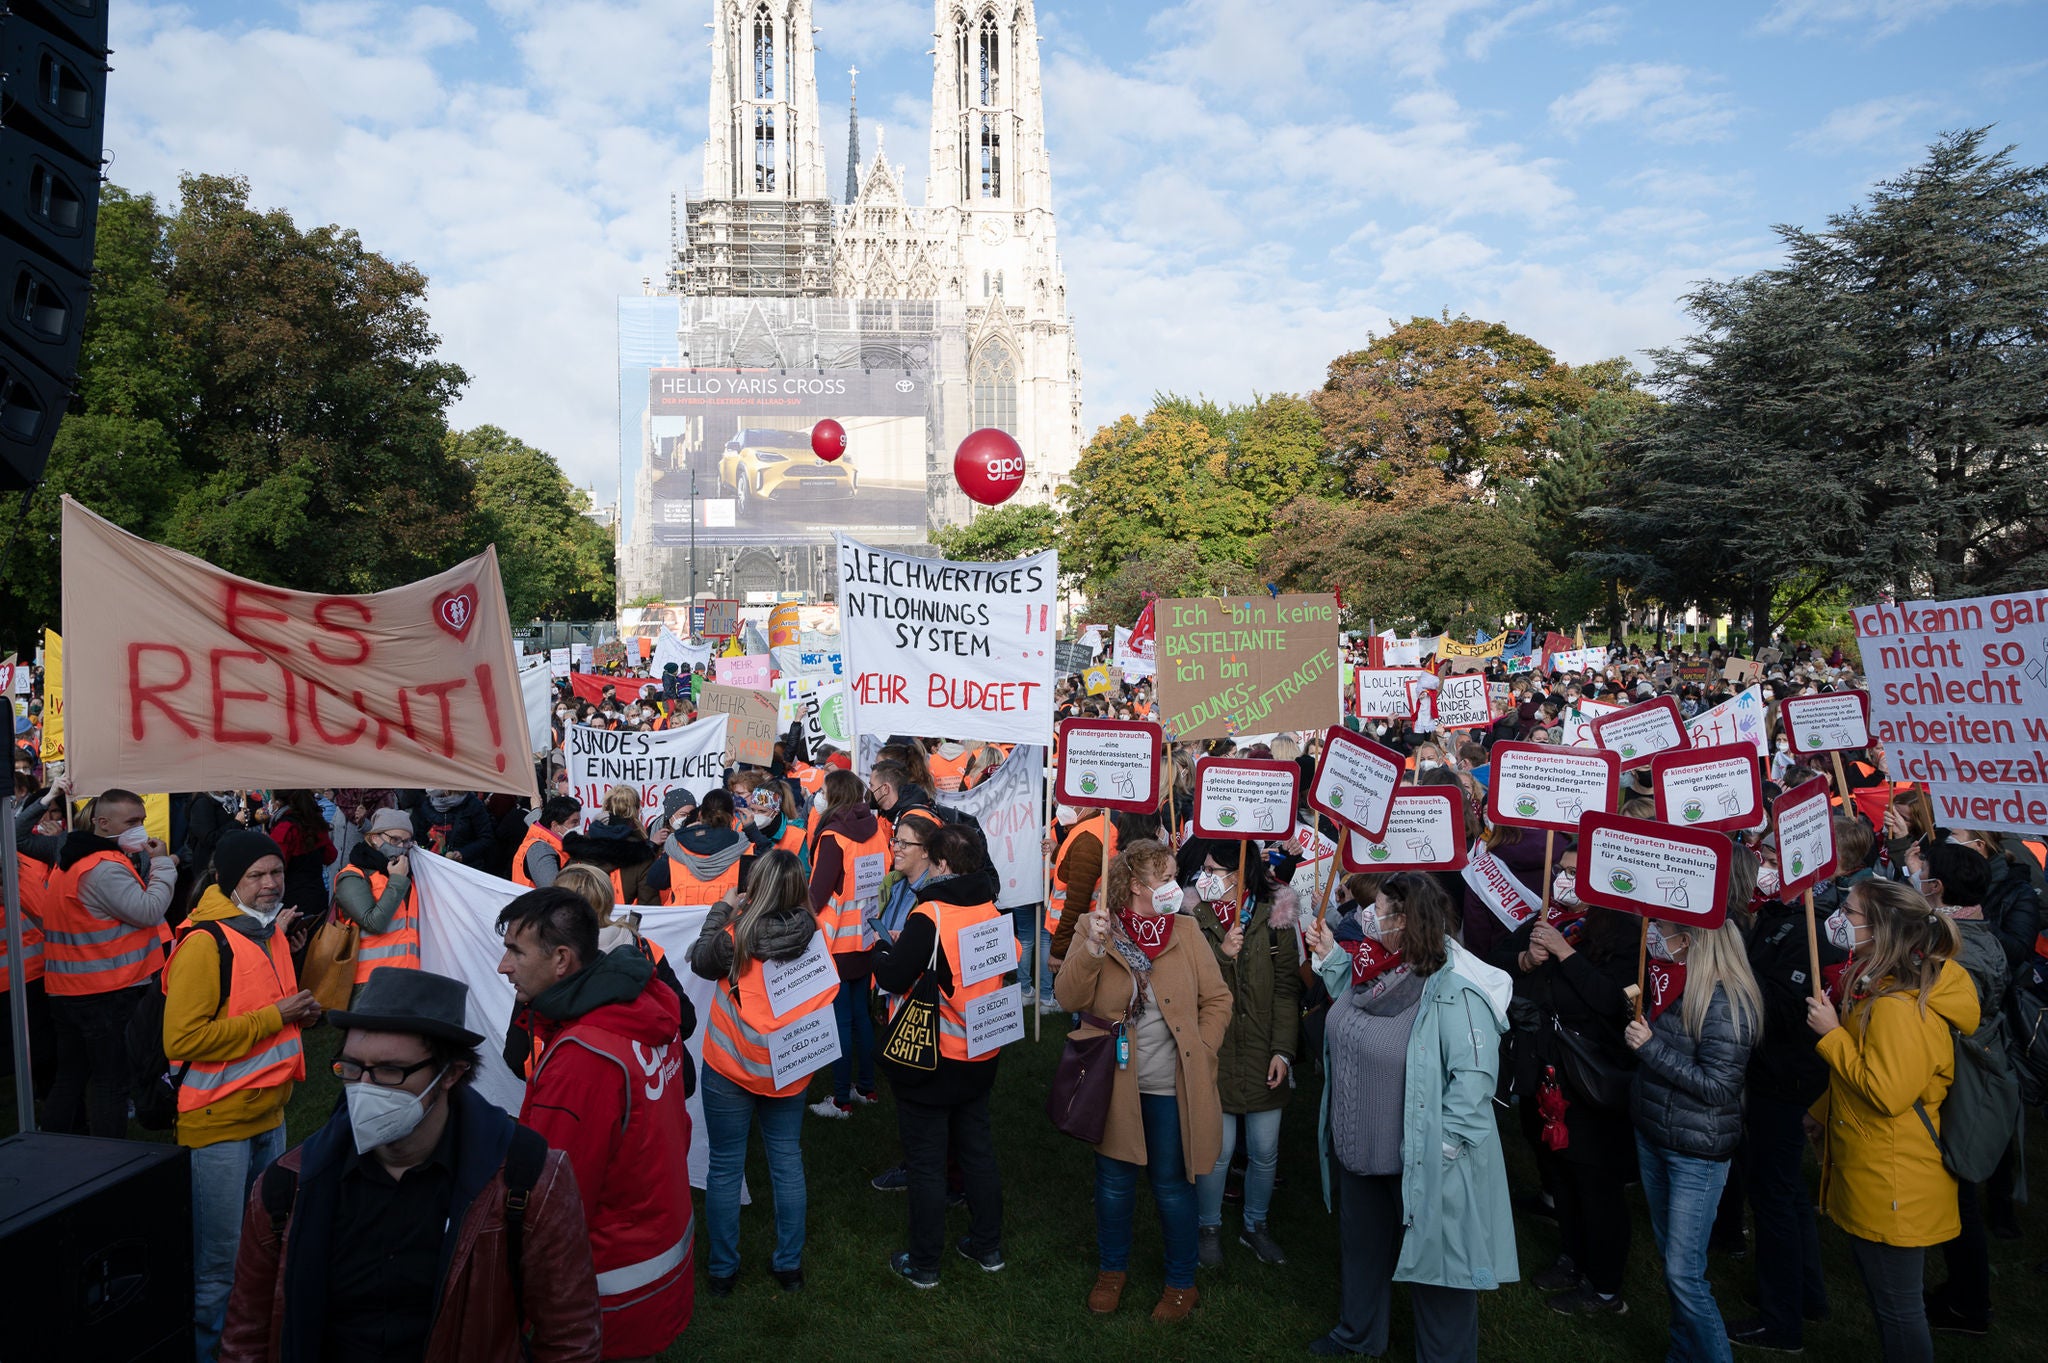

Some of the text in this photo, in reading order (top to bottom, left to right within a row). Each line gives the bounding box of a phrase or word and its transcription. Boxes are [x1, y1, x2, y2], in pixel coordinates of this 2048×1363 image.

[661, 378, 846, 394] HELLO YARIS CROSS
[987, 457, 1023, 481] gpa
[847, 592, 990, 626] NTLOHNUNGS
[1172, 601, 1332, 628] Ich bin keine
[1900, 601, 1984, 634] kann
[224, 582, 373, 665] ES
[896, 623, 991, 657] SYSTEM
[1165, 629, 1287, 656] BASTELTANTE
[1445, 637, 1505, 656] ES REICHT
[1880, 635, 2026, 669] nicht so
[730, 660, 753, 670] MEHR
[1176, 653, 1249, 682] ich bin
[851, 672, 1041, 712] MEHR BUDGET
[1382, 689, 1406, 698] AUCH
[1884, 670, 2024, 706] schlecht
[128, 641, 507, 773] REICHT!
[706, 692, 748, 716] MEHR
[1367, 701, 1411, 714] IN WIEN
[746, 719, 772, 740] FÜR
[1077, 730, 1117, 739] kindergarten
[1879, 711, 2016, 744] arbeiten
[572, 728, 668, 756] BUNDES-
[739, 738, 772, 759] KIND
[587, 752, 726, 781] EINHEITLICHES
[1080, 758, 1098, 766] jeden
[1511, 754, 1564, 764] kindergarten
[1671, 762, 1717, 776] kindergarten
[1897, 750, 1948, 782] ich
[1215, 768, 1260, 777] kindergarten
[1348, 757, 1360, 767] Geld
[1374, 770, 1383, 779] des
[1384, 774, 1395, 784] BIP
[1349, 768, 1367, 781] für die
[1518, 773, 1605, 786] Sonderkindergarten-
[1534, 766, 1606, 778] Psycholog_Innen
[1705, 773, 1727, 781] Kinder
[1206, 786, 1264, 795] Unterstützungen
[1237, 779, 1280, 788] Bedingungen
[1692, 783, 1729, 792] Gruppen...
[1605, 830, 1666, 849] kindergarten
[1601, 850, 1705, 878] für Assistent_Innen...
[1624, 846, 1661, 860] bessere
[1663, 853, 1716, 871] Bezahlung
[986, 938, 999, 950] ZEIT
[906, 1005, 932, 1027] NEXT
[978, 1004, 986, 1015] ES
[782, 1032, 793, 1042] WIR
[899, 1021, 932, 1046] LEVEL
[791, 1038, 810, 1054] GELD
[891, 1038, 924, 1062] SHIT
